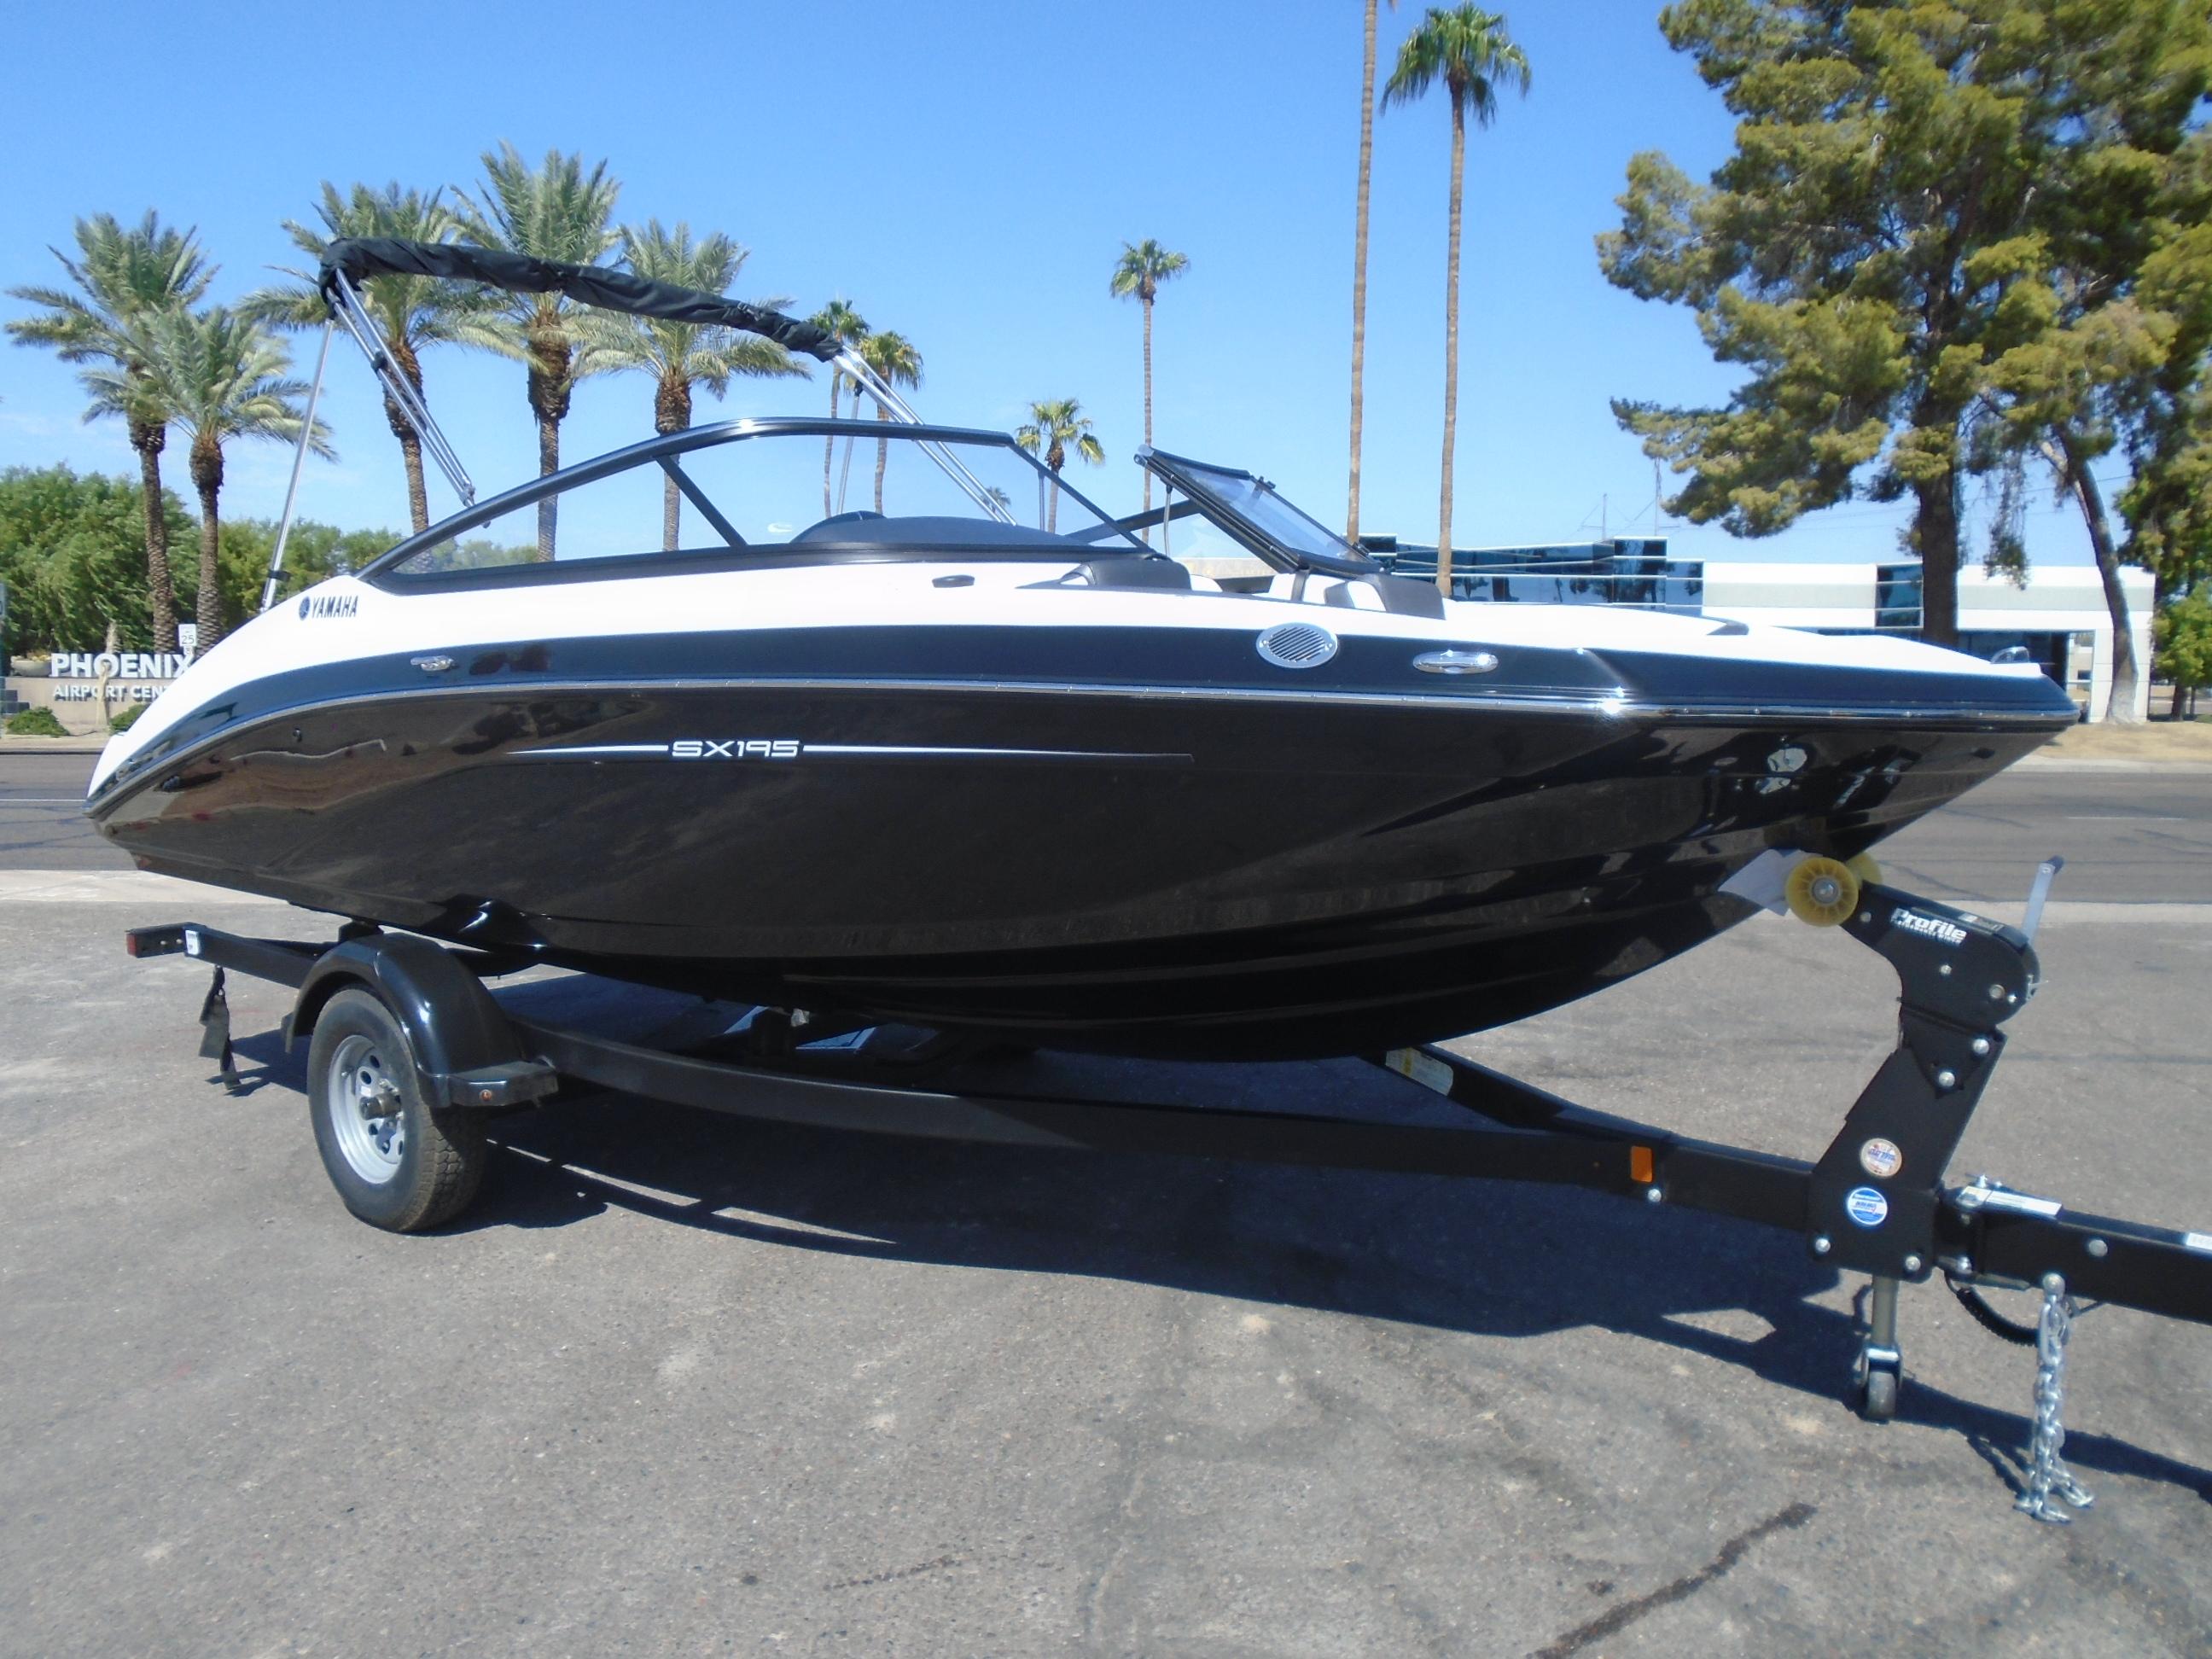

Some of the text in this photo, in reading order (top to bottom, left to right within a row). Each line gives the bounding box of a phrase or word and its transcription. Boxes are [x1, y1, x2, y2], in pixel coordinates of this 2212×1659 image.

[312, 596, 358, 618] YAMAHA
[182, 635, 195, 644] 25
[50, 653, 195, 678] PHOENIX
[130, 685, 168, 698] CEN
[672, 740, 800, 757] SX195
[1891, 907, 1967, 940] Profile
